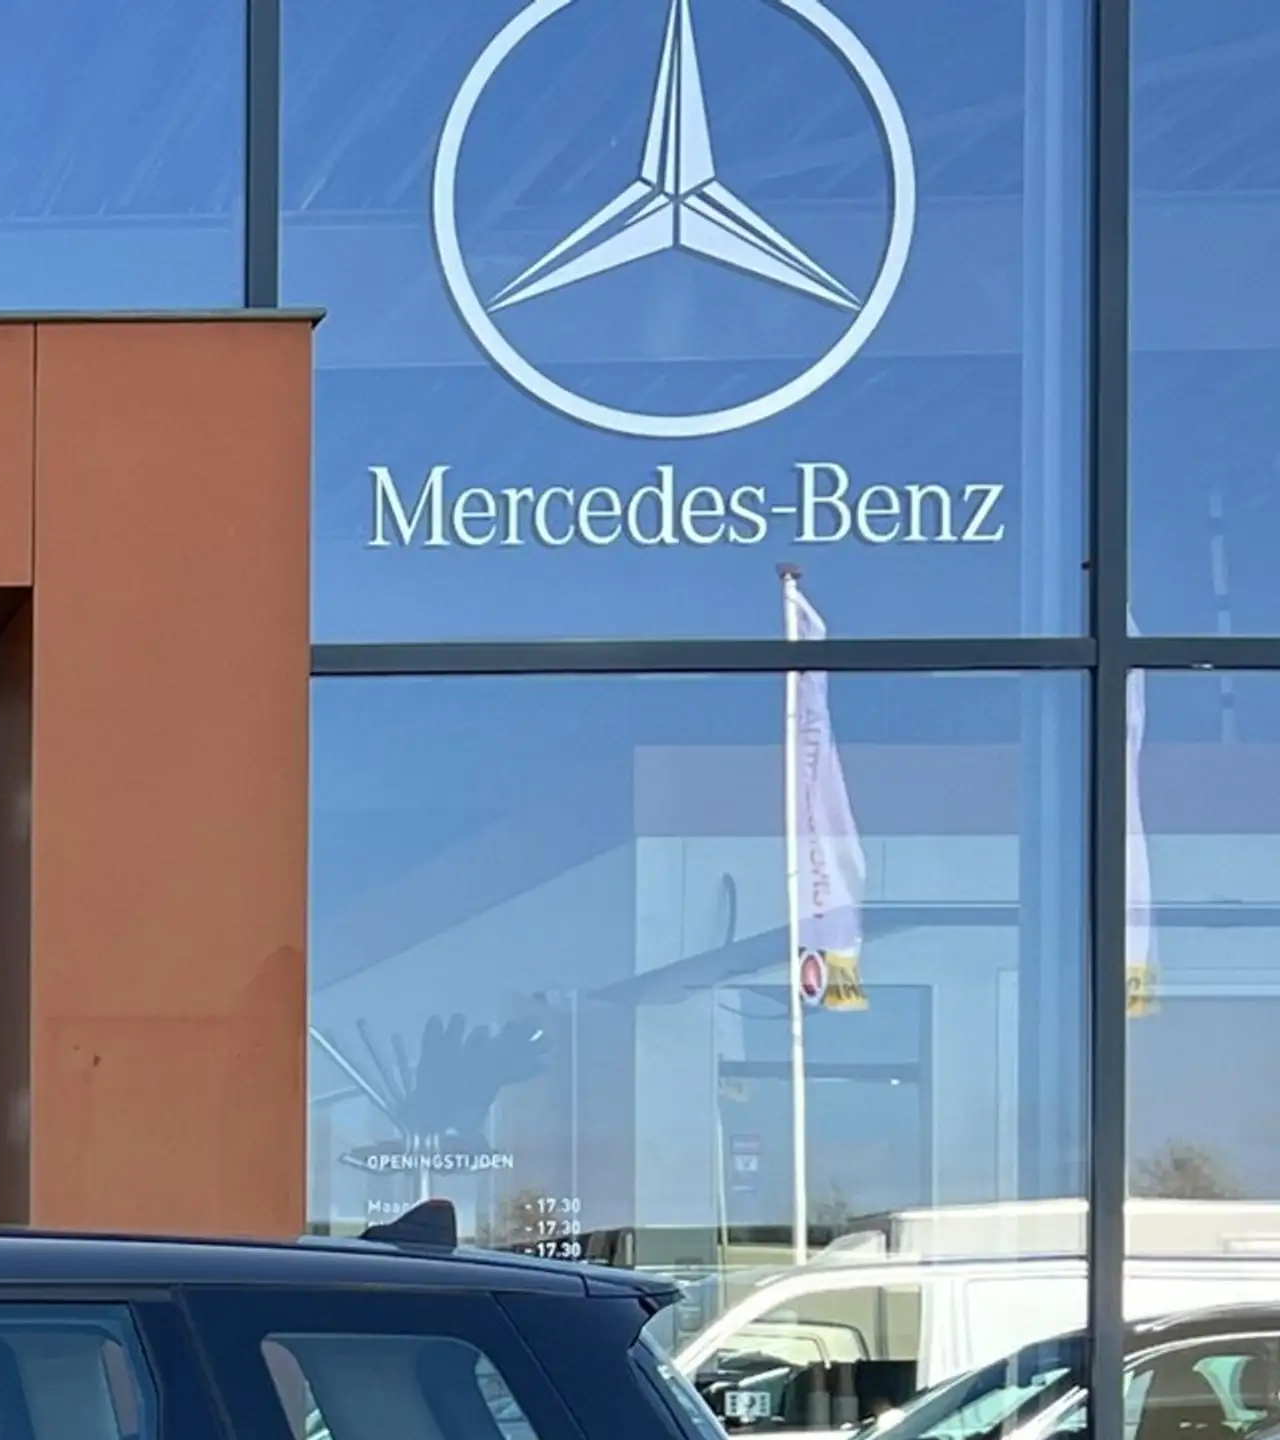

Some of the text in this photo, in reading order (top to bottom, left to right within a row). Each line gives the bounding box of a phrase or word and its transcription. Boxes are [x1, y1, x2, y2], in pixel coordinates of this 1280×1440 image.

[367, 462, 1006, 546] Mercedes-Benz
[367, 1153, 514, 1171] OPENINGSTIJDEN
[537, 1197, 581, 1214] 17.30
[537, 1219, 581, 1235] 17.30
[537, 1241, 582, 1258] 17.30
